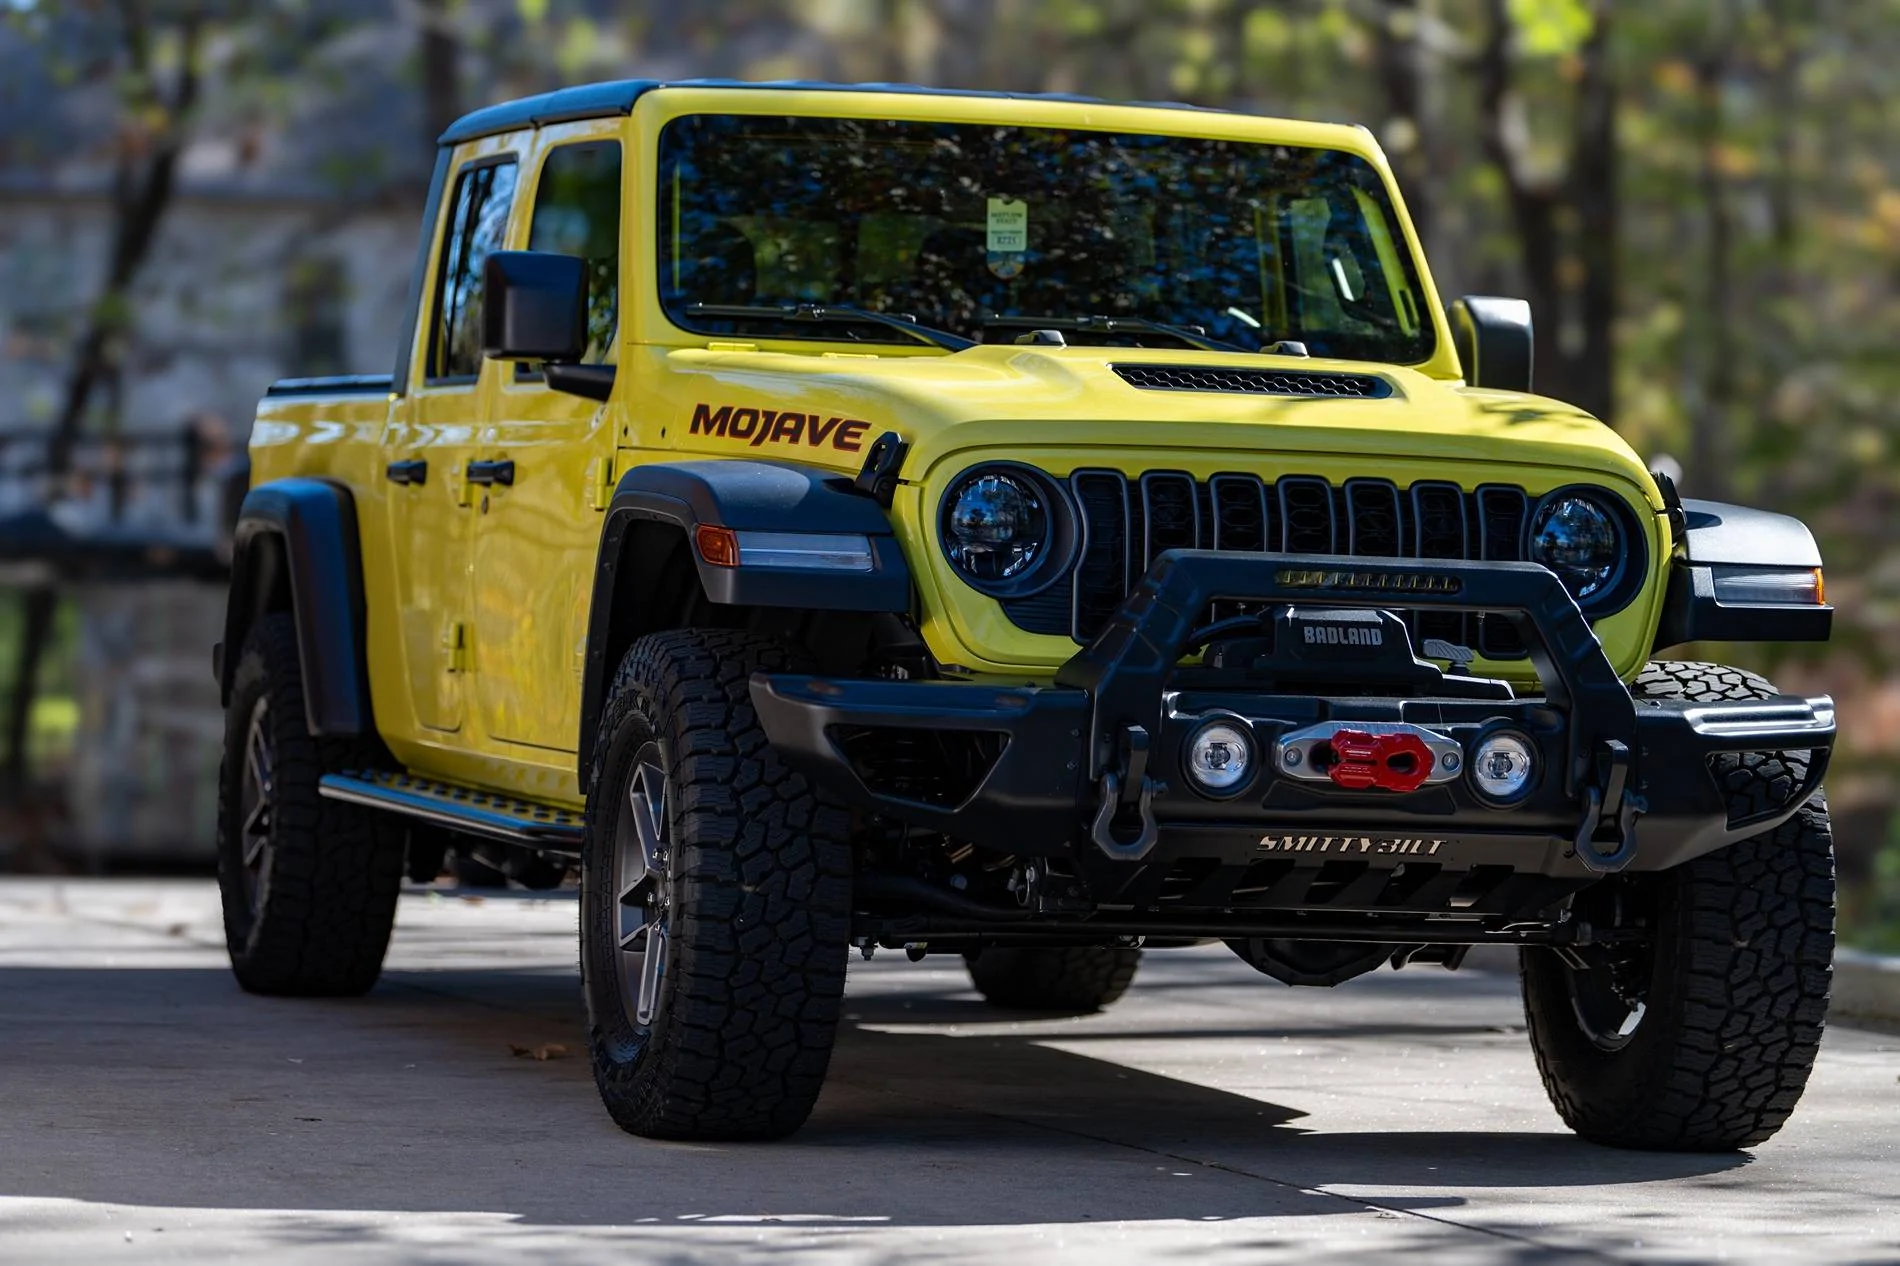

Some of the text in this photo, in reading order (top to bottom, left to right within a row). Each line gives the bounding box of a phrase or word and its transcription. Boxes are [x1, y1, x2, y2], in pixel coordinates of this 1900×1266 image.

[689, 403, 872, 452] MOJAVE
[1303, 626, 1383, 646] BADLAND
[1256, 835, 1447, 855] SMITTYBILT
